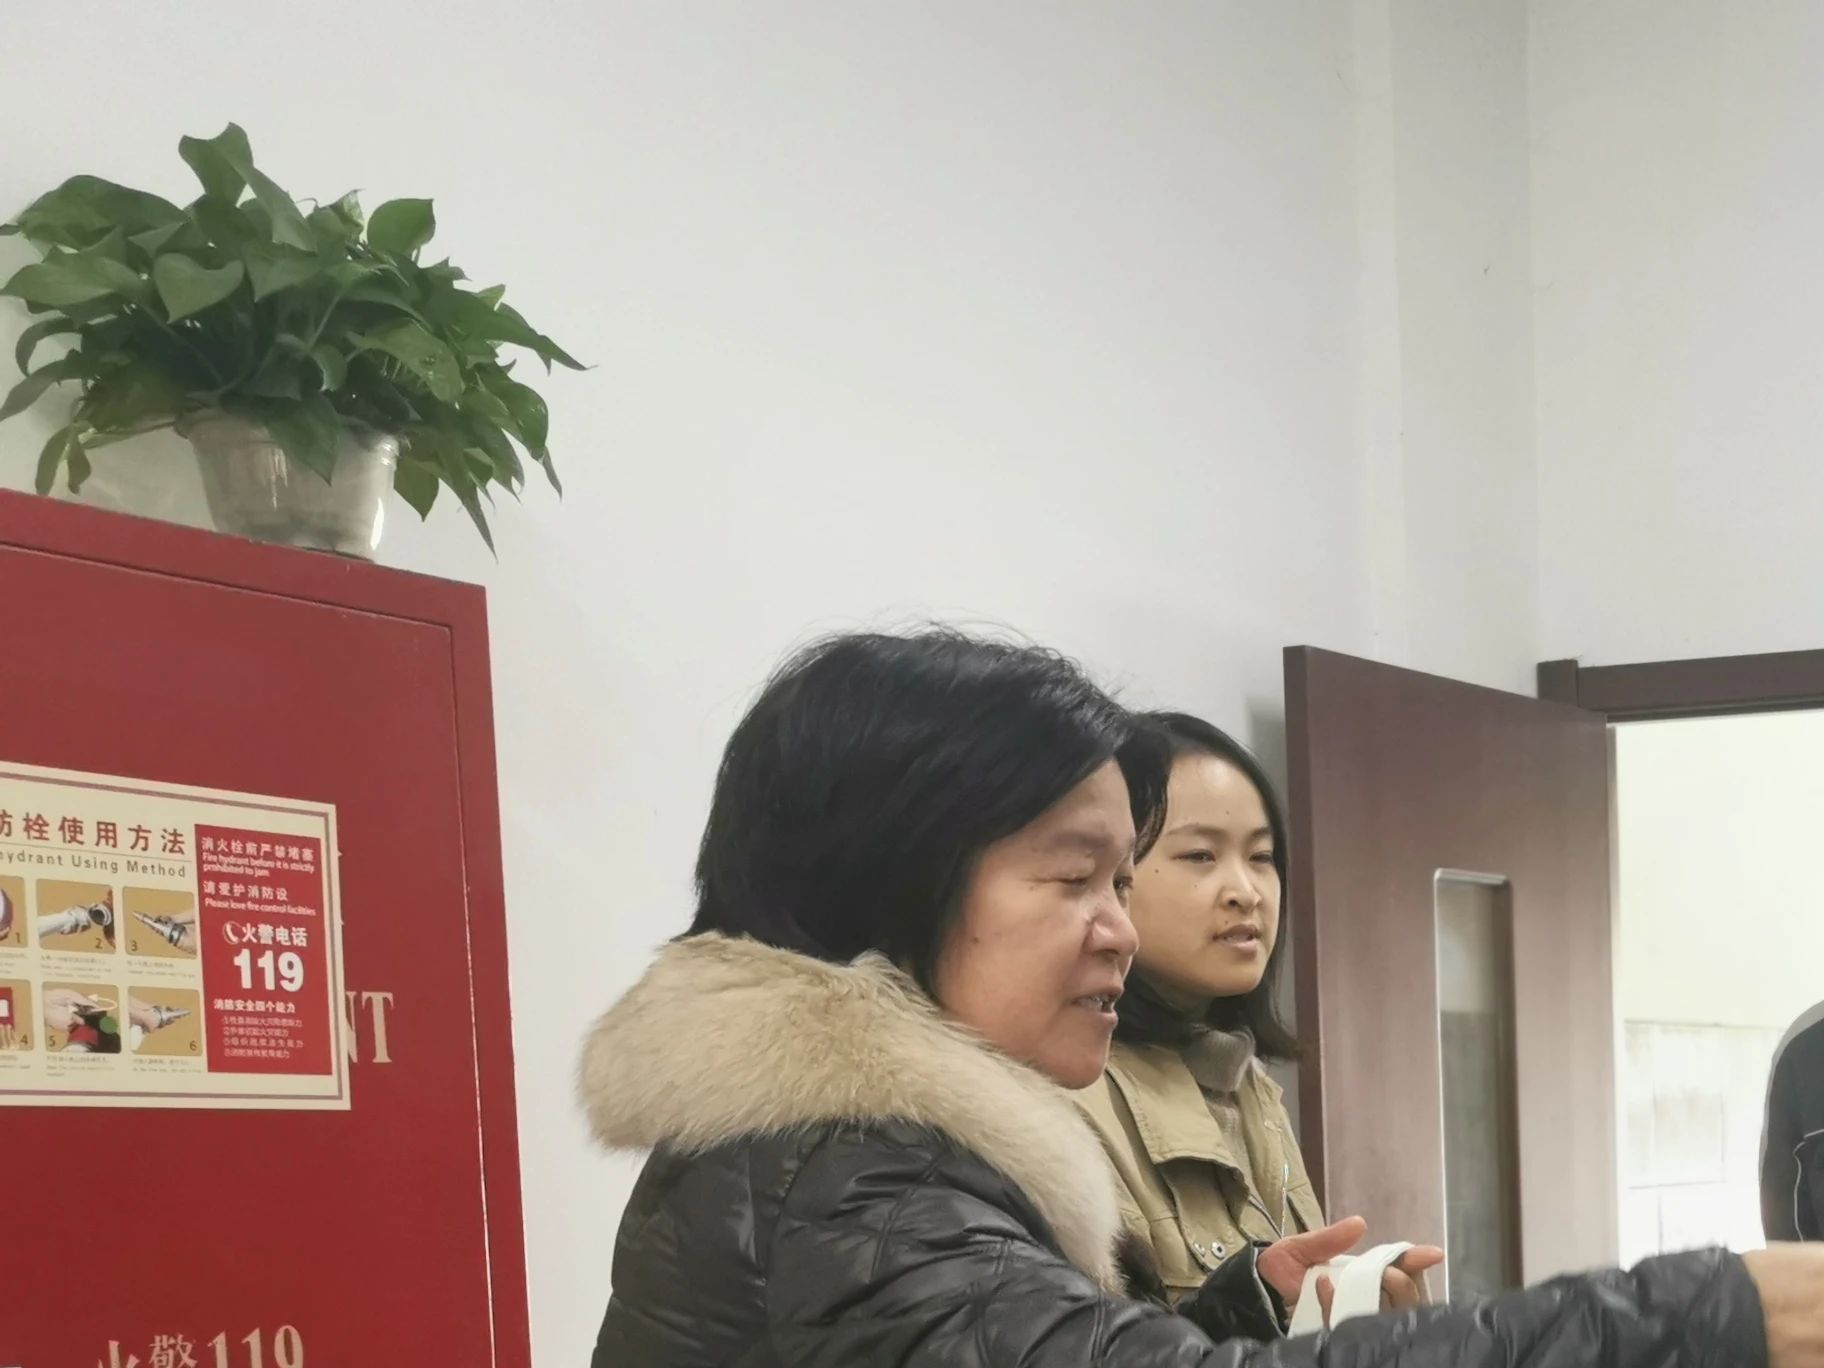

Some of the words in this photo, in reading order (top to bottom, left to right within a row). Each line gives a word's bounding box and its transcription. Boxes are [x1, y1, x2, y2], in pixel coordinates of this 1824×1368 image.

[71, 855, 119, 874] Using
[126, 860, 186, 878] Method
[15, 932, 21, 944] 1
[241, 922, 308, 947] 火警电话
[95, 937, 103, 950] 2
[130, 939, 138, 952] 3
[233, 948, 304, 992] 119
[20, 1035, 29, 1046] 4
[48, 1035, 56, 1047] 5
[189, 1040, 197, 1052] 6
